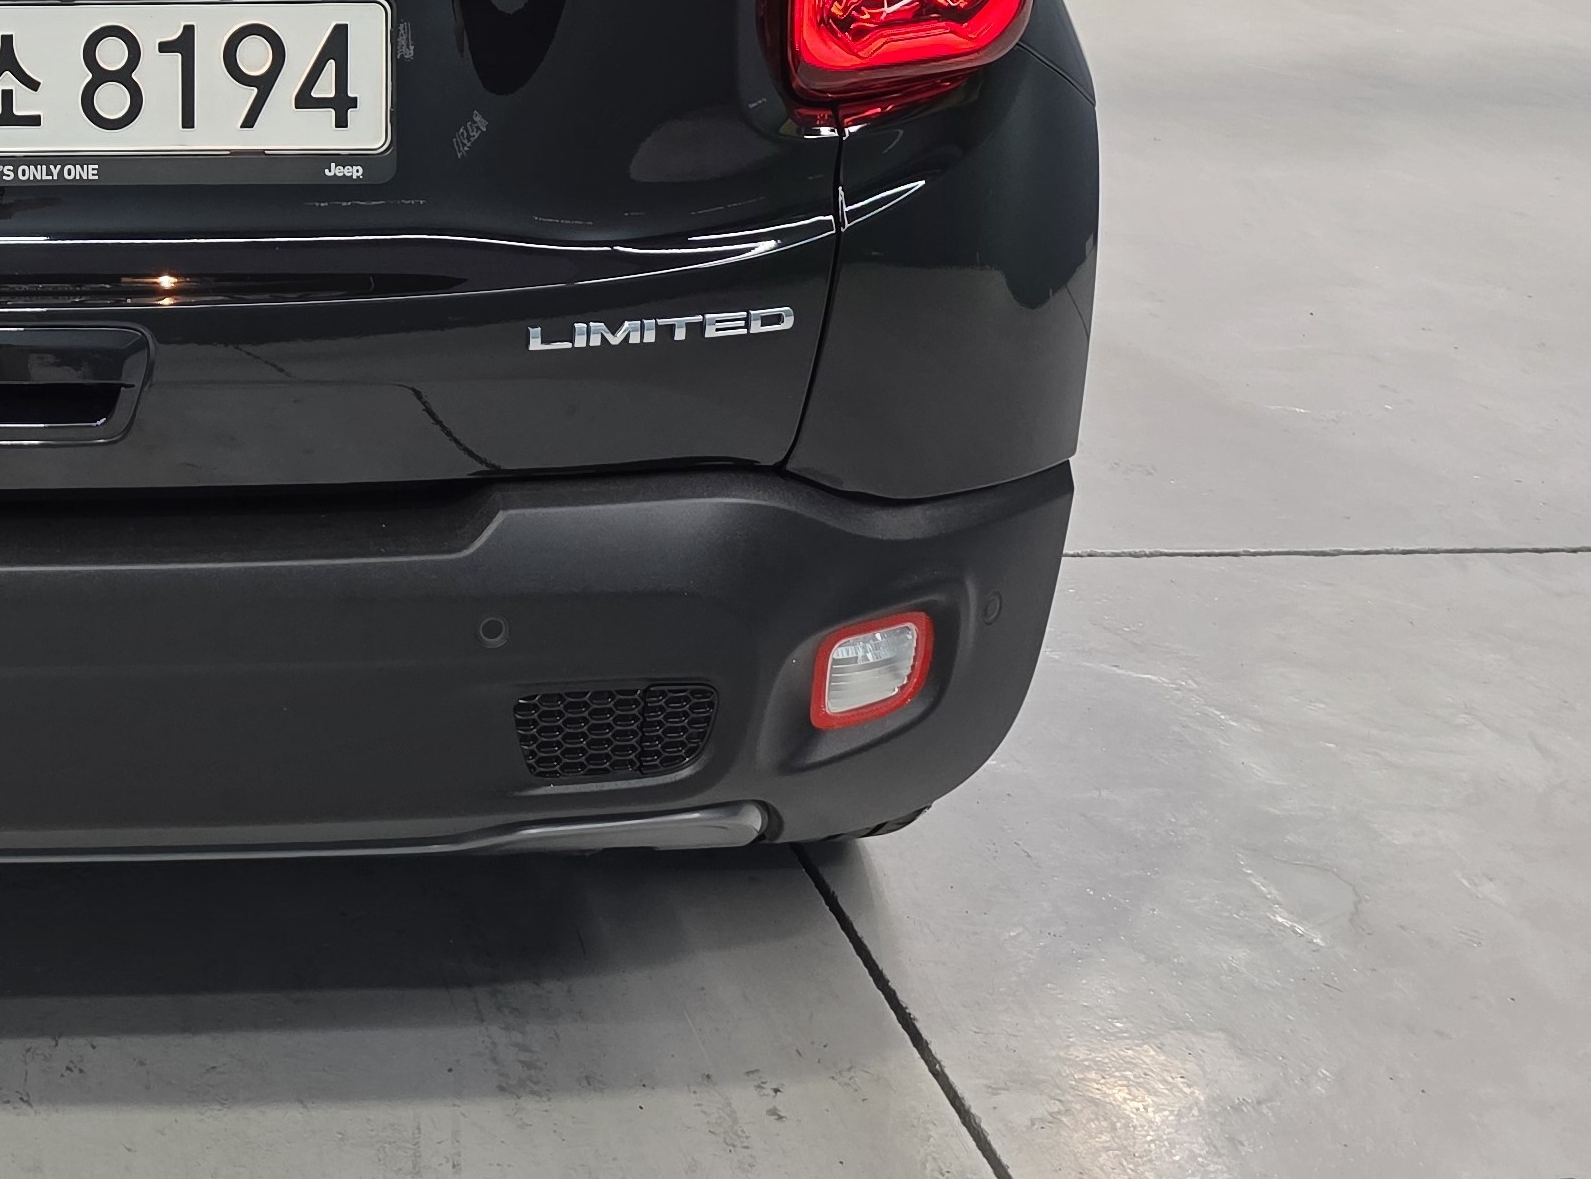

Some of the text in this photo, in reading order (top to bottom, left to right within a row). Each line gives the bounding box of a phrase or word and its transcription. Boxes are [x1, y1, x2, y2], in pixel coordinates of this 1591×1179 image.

[80, 23, 358, 131] 8194
[17, 164, 61, 181] ONLY
[63, 164, 99, 180] ONE
[324, 162, 363, 179] Jeep
[527, 306, 795, 351] LIMITED
